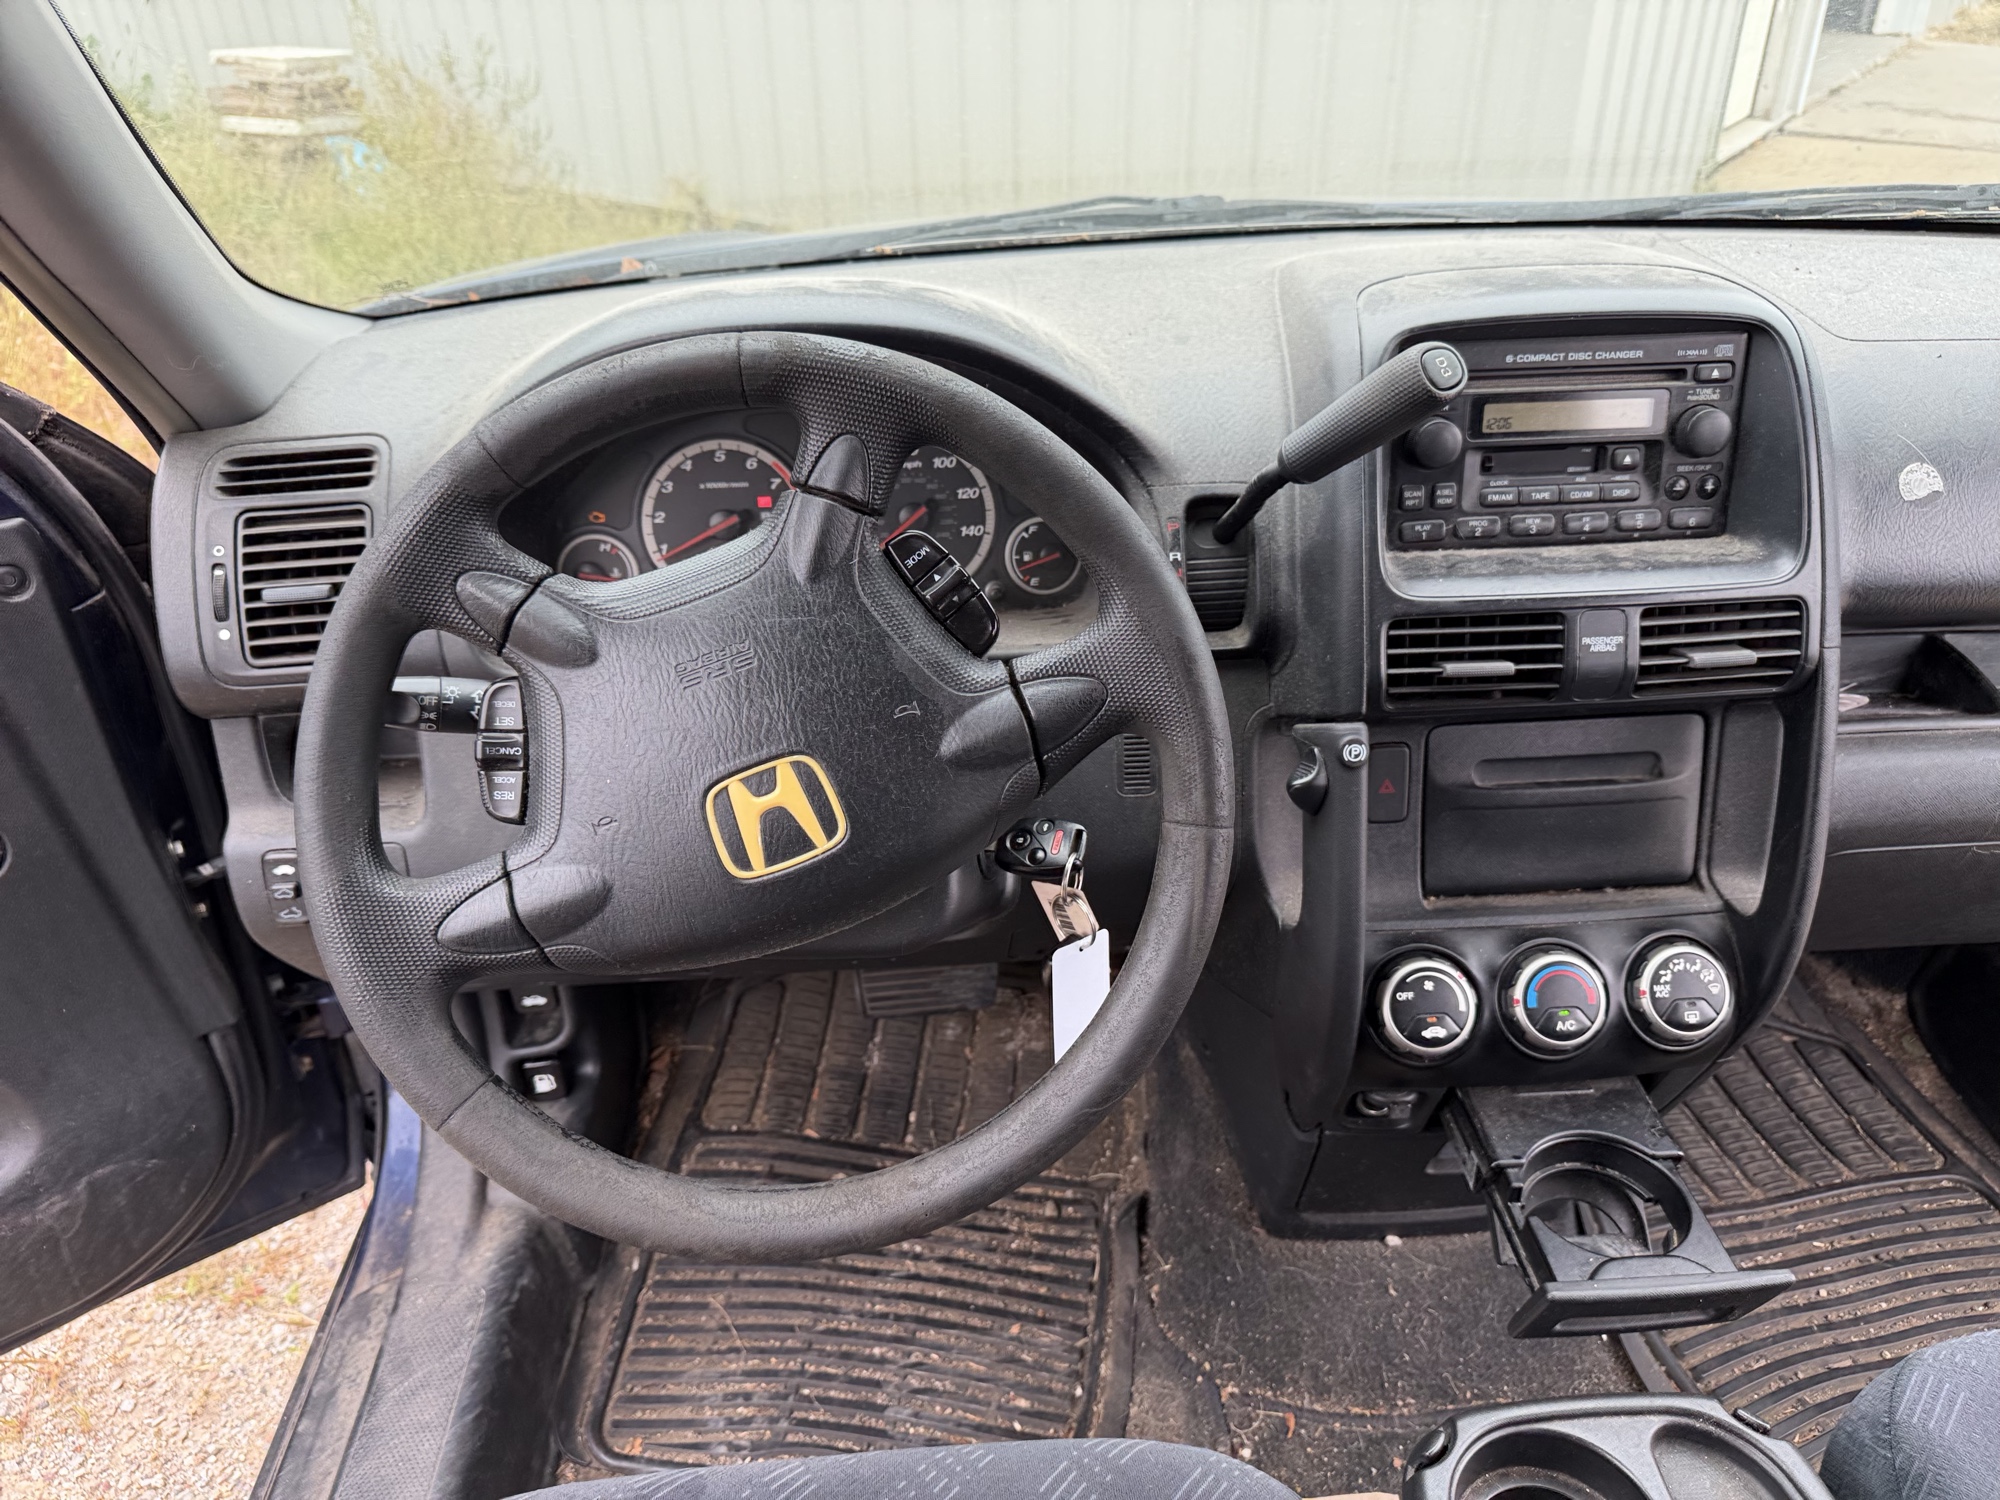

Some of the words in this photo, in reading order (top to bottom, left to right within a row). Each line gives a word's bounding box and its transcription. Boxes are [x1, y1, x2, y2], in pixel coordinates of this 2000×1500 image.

[1506, 352, 1566, 363] 6-COMPACT
[1568, 351, 1593, 361] DISC
[1595, 350, 1644, 360] CHANGER
[713, 450, 727, 463] 5
[680, 459, 693, 472] 4
[745, 457, 759, 470] 6
[932, 456, 957, 469] 100
[660, 480, 674, 494] 3
[769, 477, 782, 490] 7
[956, 486, 980, 500] 120
[1403, 490, 1422, 498] SCAN
[1487, 493, 1513, 502] FM/AM
[1531, 491, 1551, 500] TAPE
[1570, 490, 1593, 499] CD/XM
[1612, 488, 1631, 497] DISP
[653, 511, 666, 524] 2
[1688, 517, 1696, 527] 6
[1414, 524, 1431, 532] PLAY
[1529, 524, 1537, 534] 3
[1583, 523, 1590, 532] 4
[1636, 520, 1643, 529] 5
[960, 524, 985, 538] 140
[1028, 525, 1039, 535] F
[1474, 527, 1482, 537] 2
[598, 543, 612, 553] H
[659, 543, 669, 556] 1
[904, 544, 931, 570] MODE
[1029, 577, 1040, 587] E
[1581, 635, 1624, 646] PASSENGER
[1589, 643, 1617, 653] AIRBAG
[418, 695, 439, 706] OFF
[494, 716, 515, 726] SET
[484, 746, 522, 756] CANCEL
[492, 776, 517, 784] ACCEL
[493, 790, 515, 800] RES
[1652, 983, 1671, 992] MAX
[1395, 991, 1415, 1001] OFF
[1655, 990, 1670, 998] A/C
[1555, 1020, 1577, 1032] A/C
